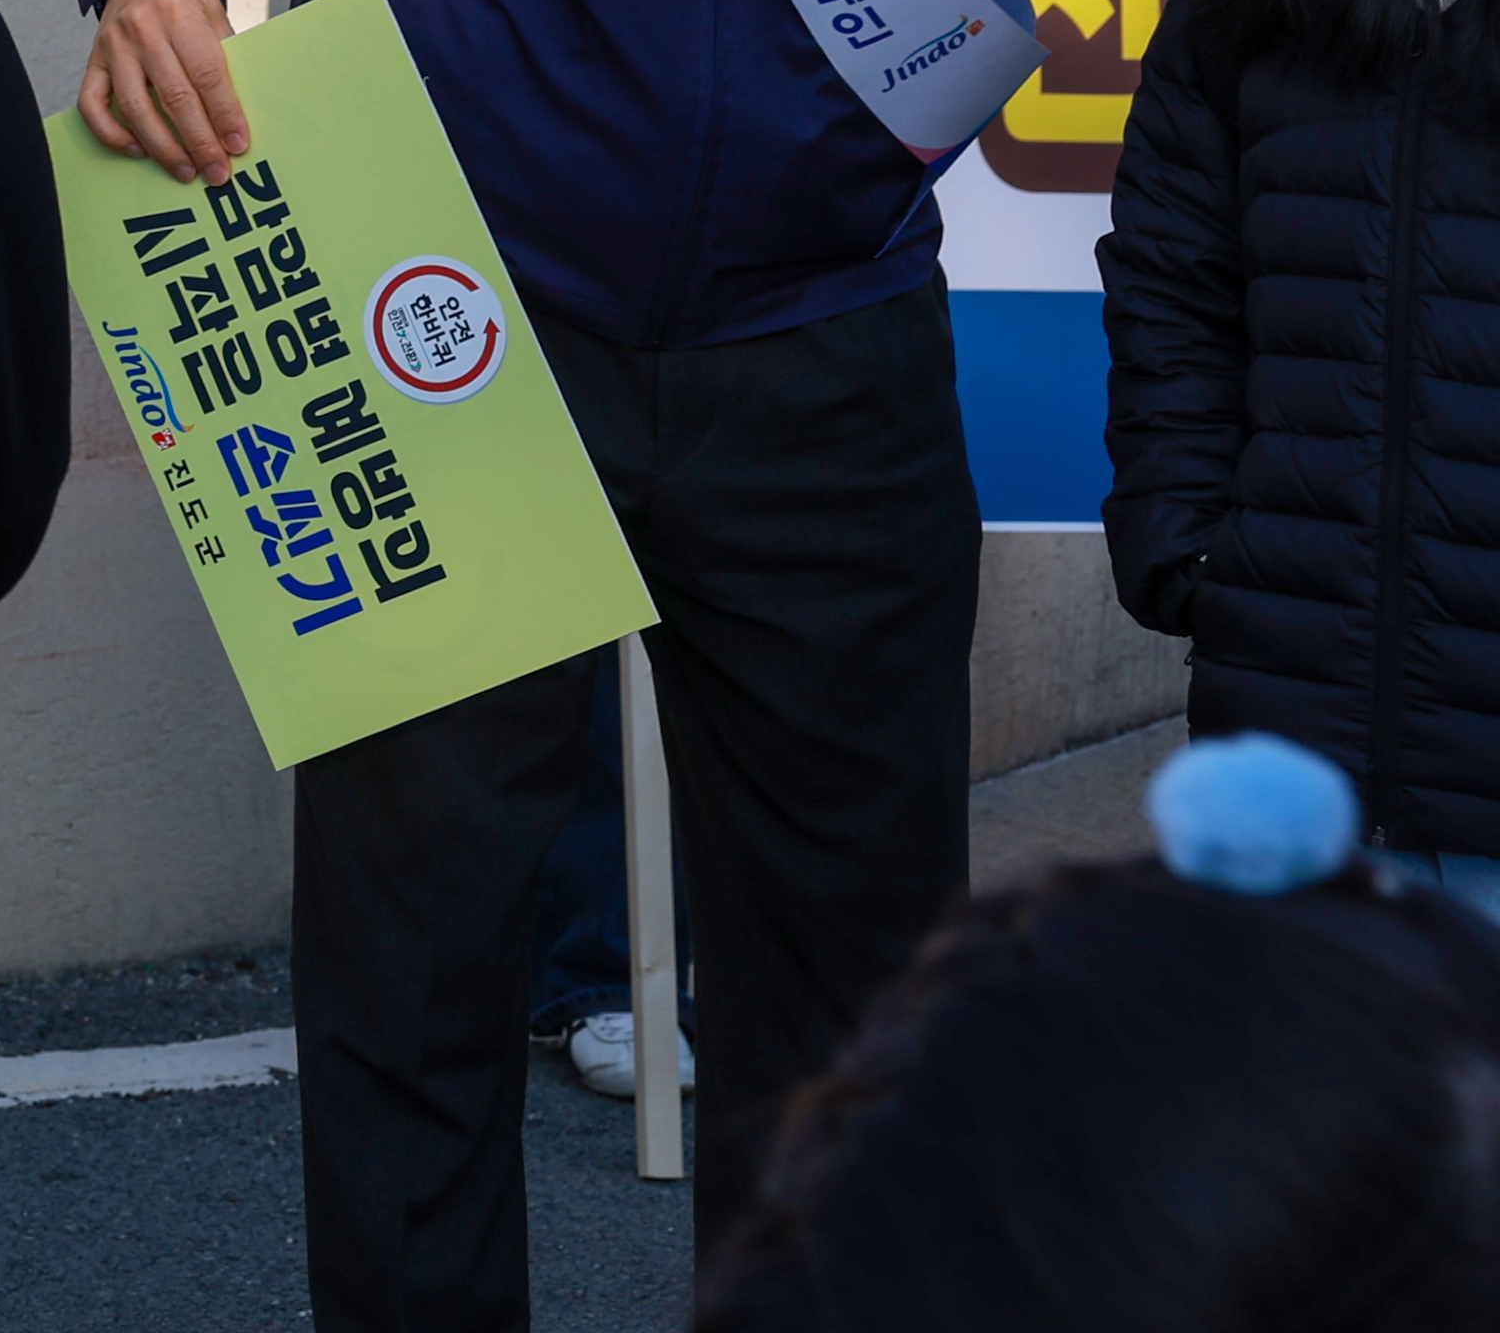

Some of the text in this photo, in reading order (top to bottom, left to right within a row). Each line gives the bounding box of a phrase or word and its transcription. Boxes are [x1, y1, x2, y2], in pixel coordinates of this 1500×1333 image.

[882, 28, 969, 94] Jindo
[102, 318, 170, 428] Jindo
[408, 292, 458, 368] 한바퀴
[436, 294, 478, 344] 안전
[123, 206, 364, 637] 시작은 손씻기
[201, 158, 448, 603] 감염병 예방의
[163, 459, 226, 568] 진도군
